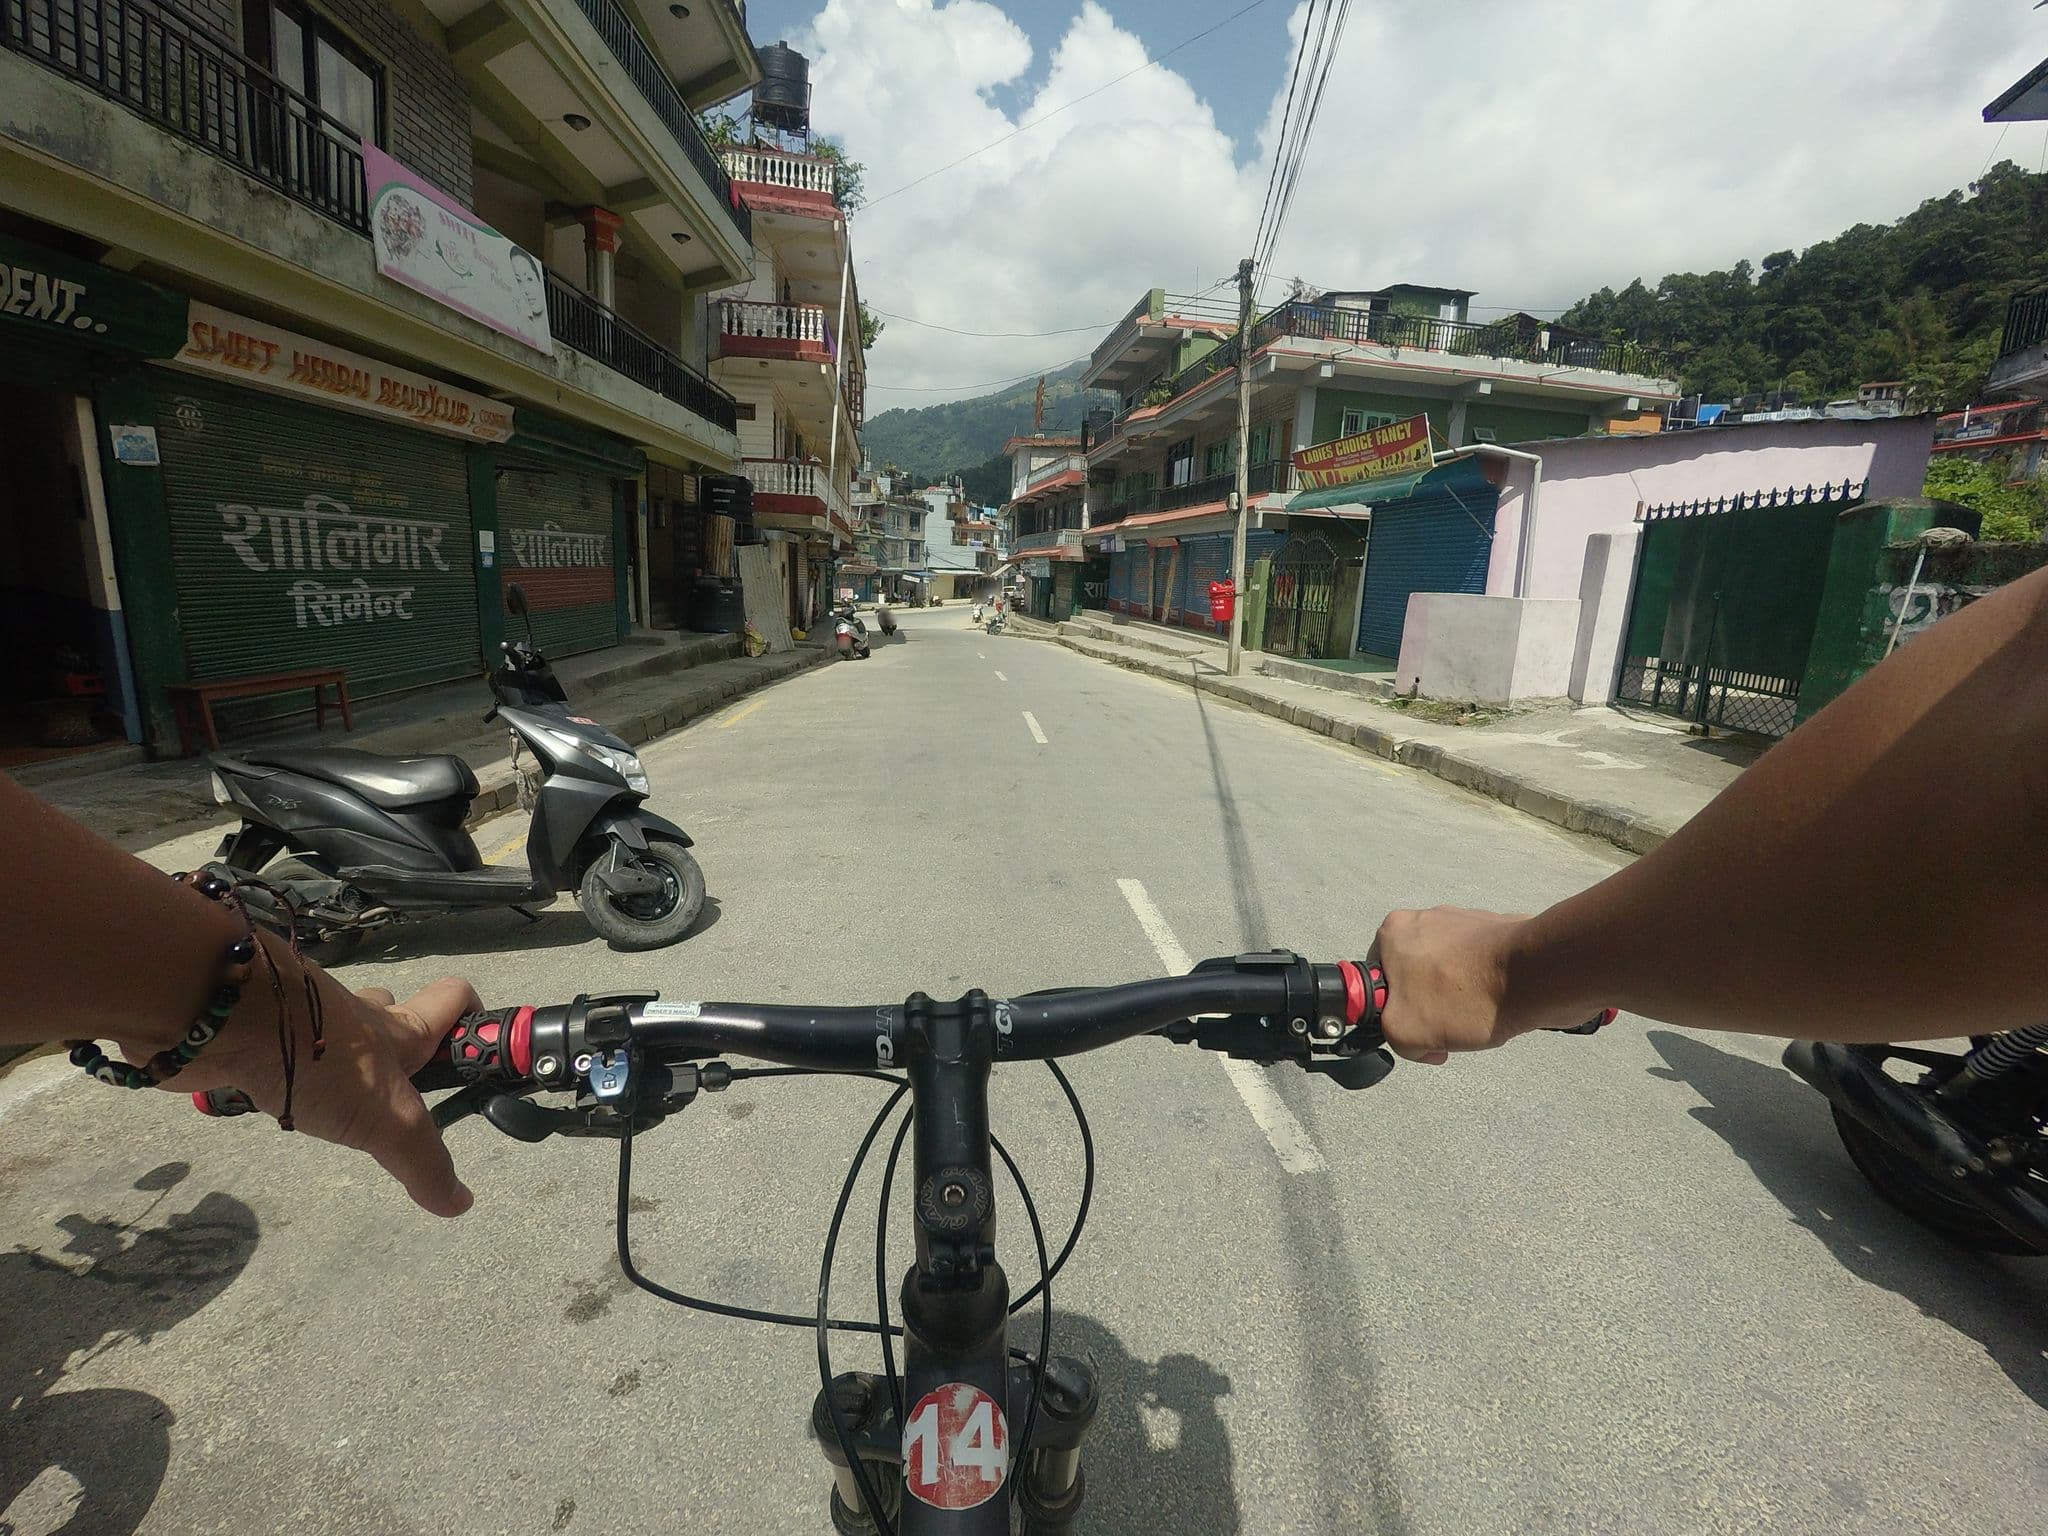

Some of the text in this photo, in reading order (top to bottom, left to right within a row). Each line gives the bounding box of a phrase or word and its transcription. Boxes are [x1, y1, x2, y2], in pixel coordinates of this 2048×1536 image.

[184, 321, 281, 375] SWEET
[287, 350, 372, 400] HERBAL
[1302, 445, 1333, 464] LADIES
[1336, 433, 1373, 453] CHOICE
[1376, 422, 1412, 445] FANCY
[215, 494, 450, 572] शालिमार
[286, 578, 415, 628] सिमेन्ट
[903, 1401, 1003, 1485] 14
